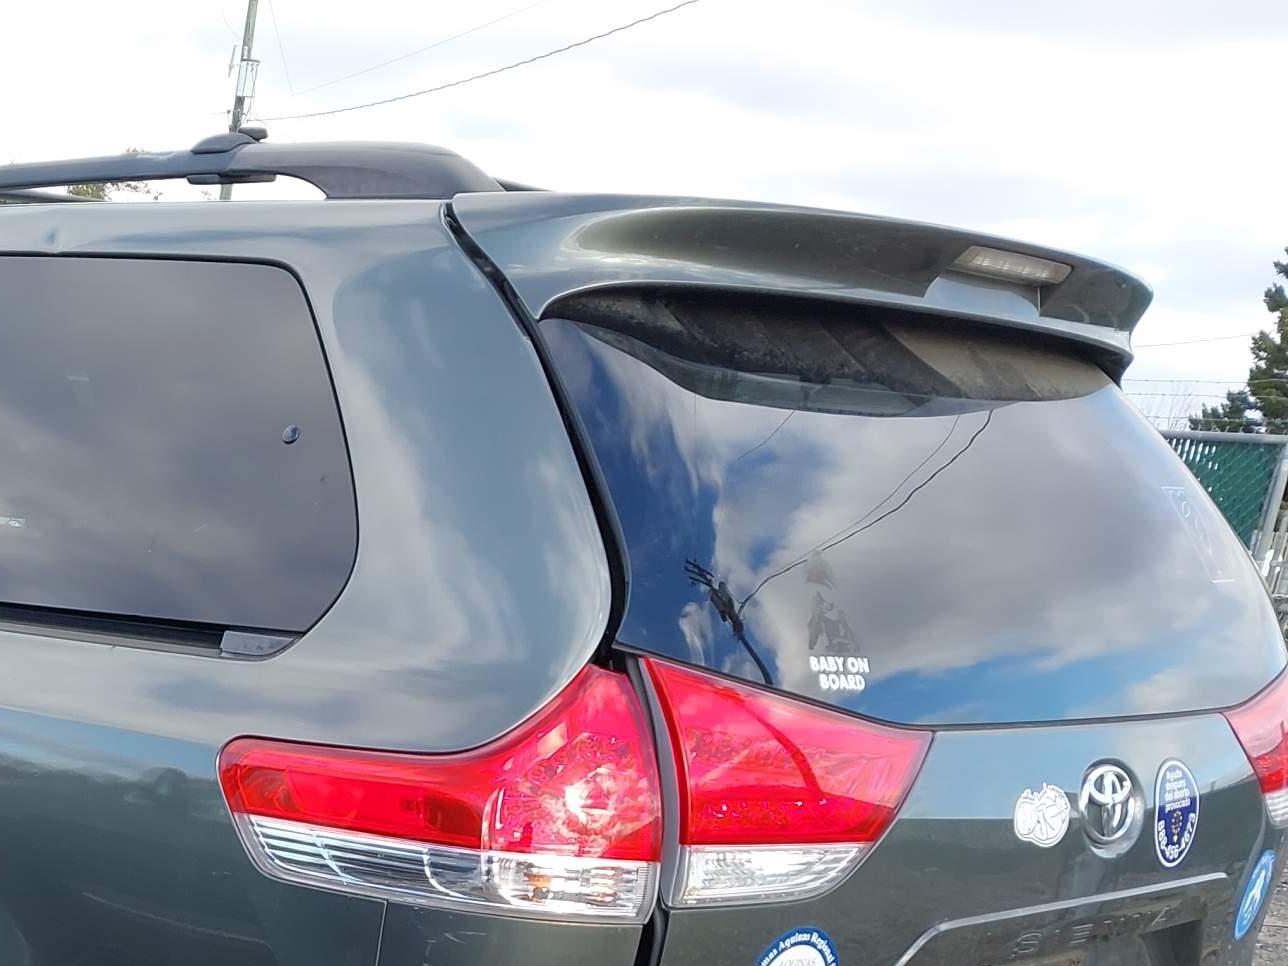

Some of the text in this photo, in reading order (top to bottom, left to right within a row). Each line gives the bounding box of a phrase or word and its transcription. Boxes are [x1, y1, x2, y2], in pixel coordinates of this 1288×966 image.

[809, 655, 870, 673] BABY ON
[819, 673, 866, 690] BOARD
[778, 932, 811, 951] Aquinas
[811, 932, 835, 963] Regional
